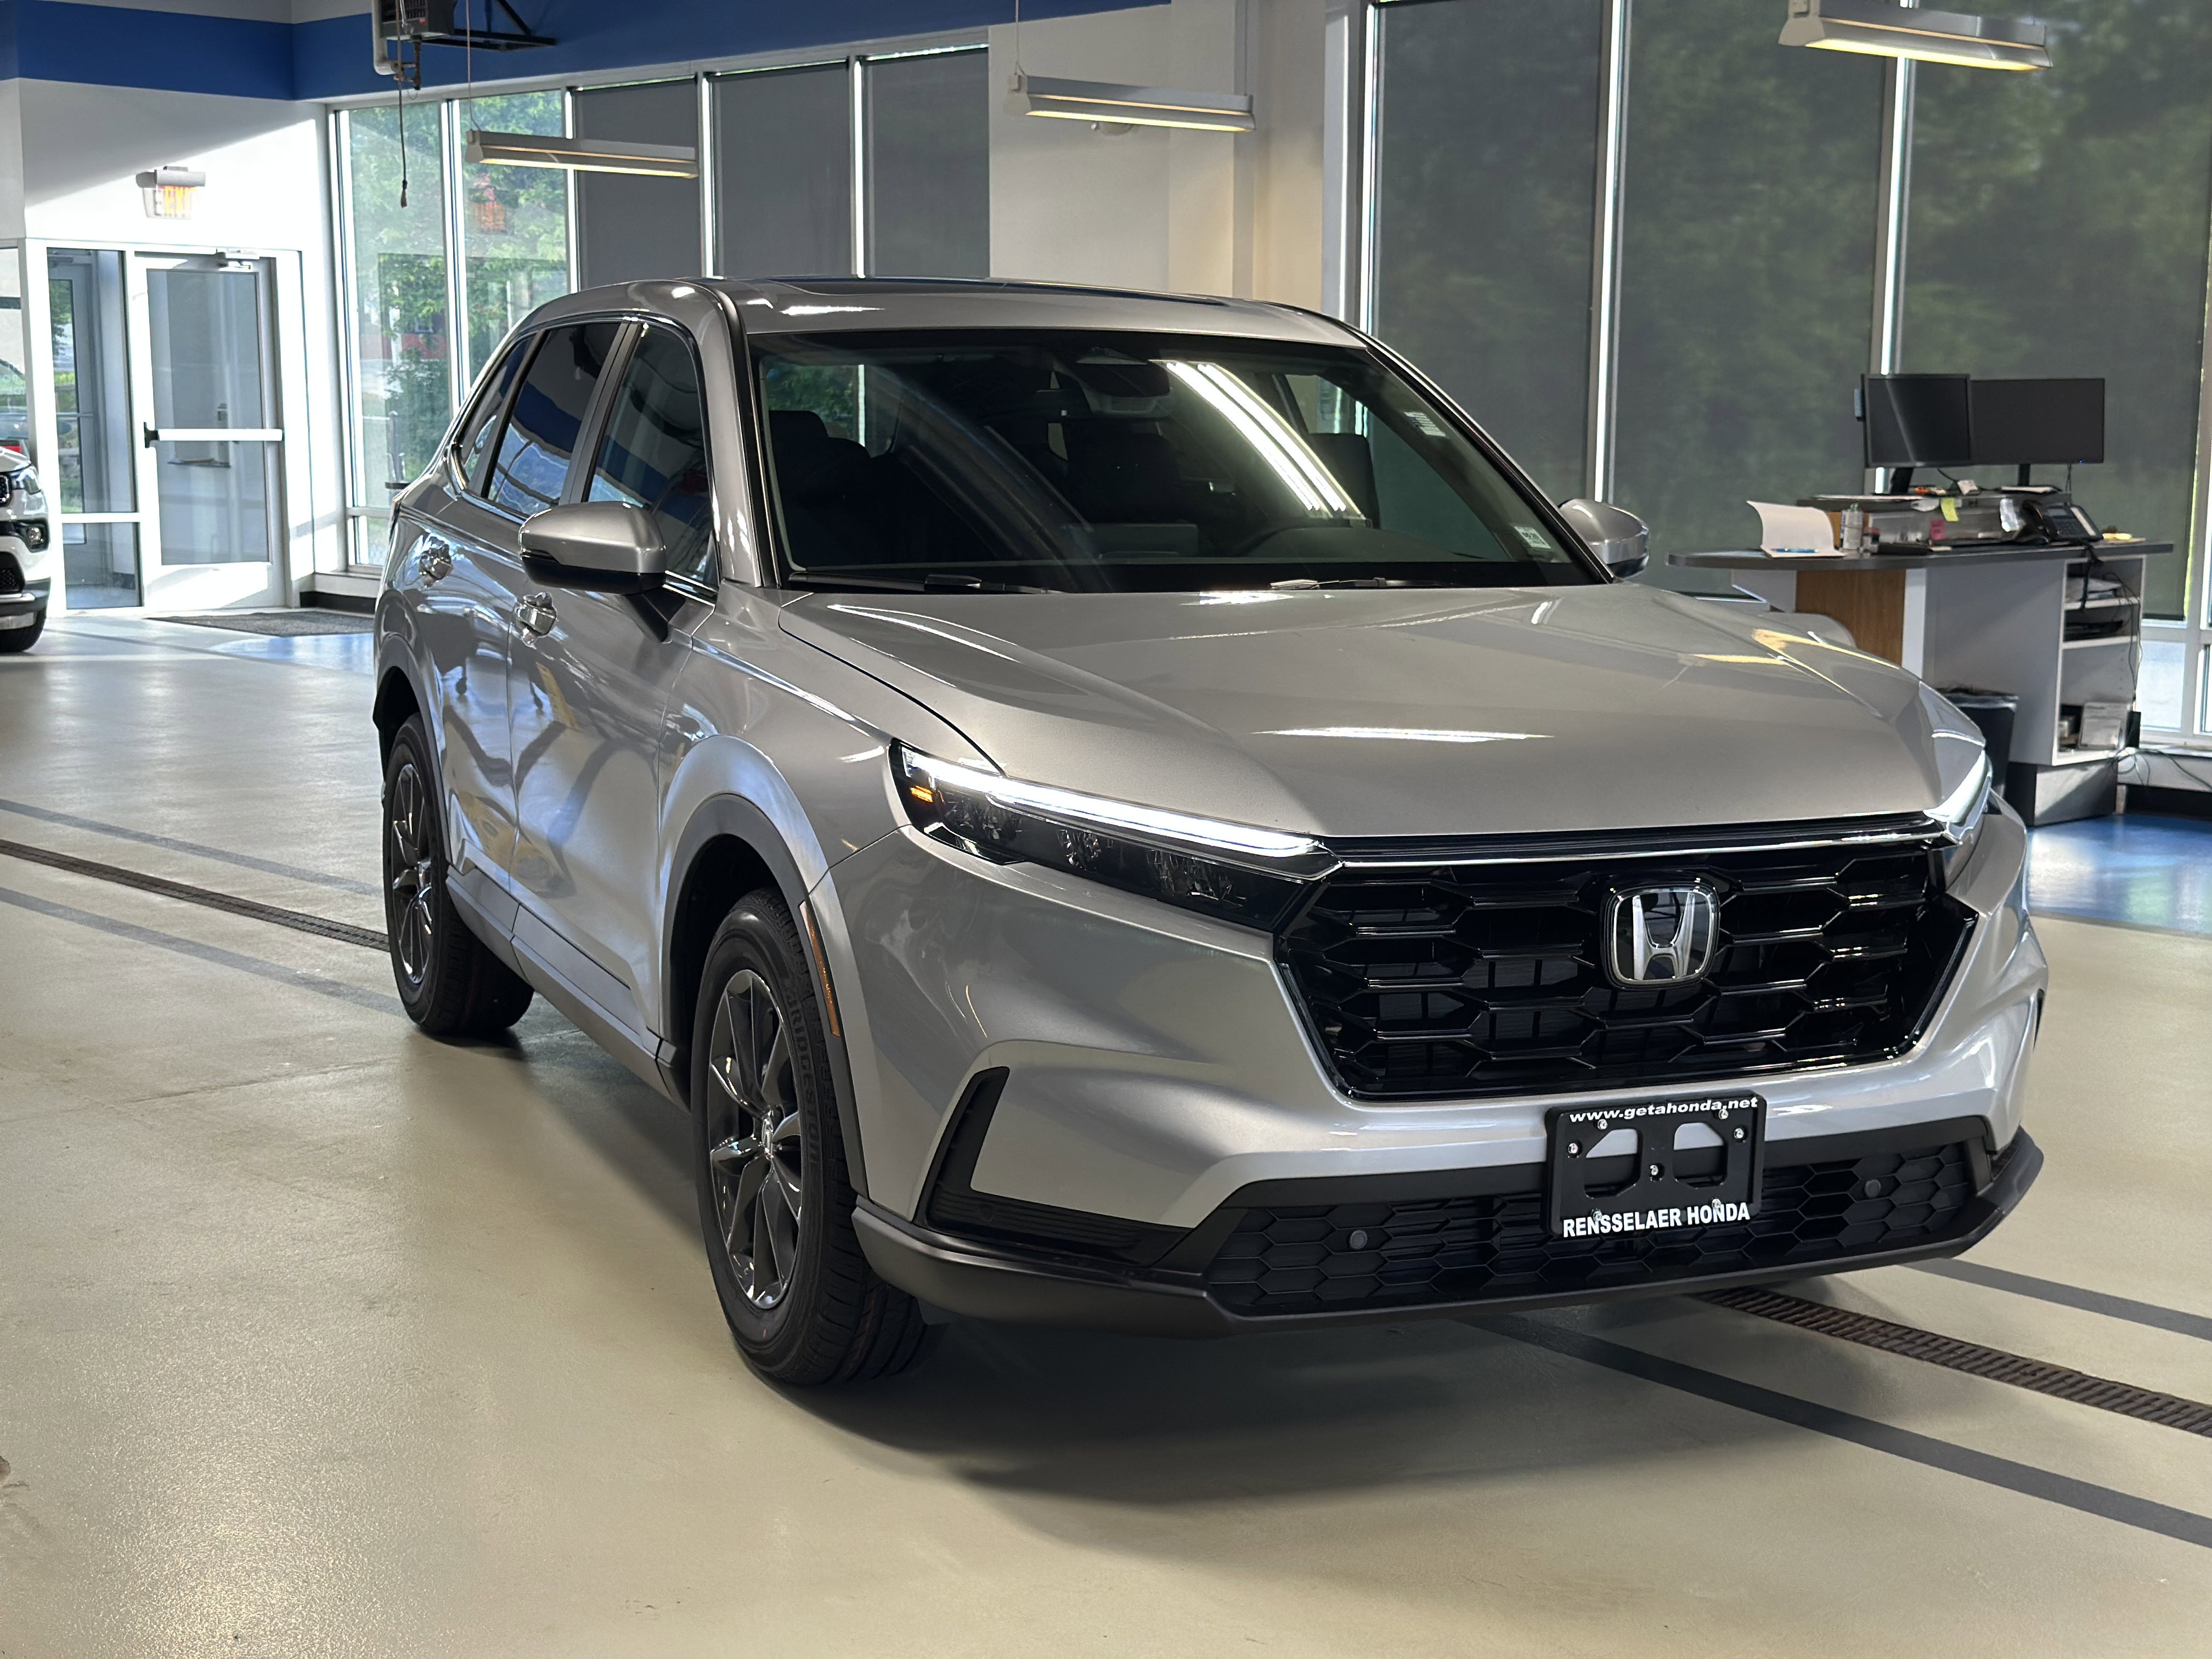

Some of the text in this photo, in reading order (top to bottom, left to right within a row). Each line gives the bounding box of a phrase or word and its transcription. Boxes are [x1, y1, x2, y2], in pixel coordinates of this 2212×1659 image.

[787, 991, 821, 1165] BRIDGESTON
[1570, 1097, 1758, 1122] www.getahonda.net
[1563, 1202, 1751, 1238] RENSSELAER HONDA
